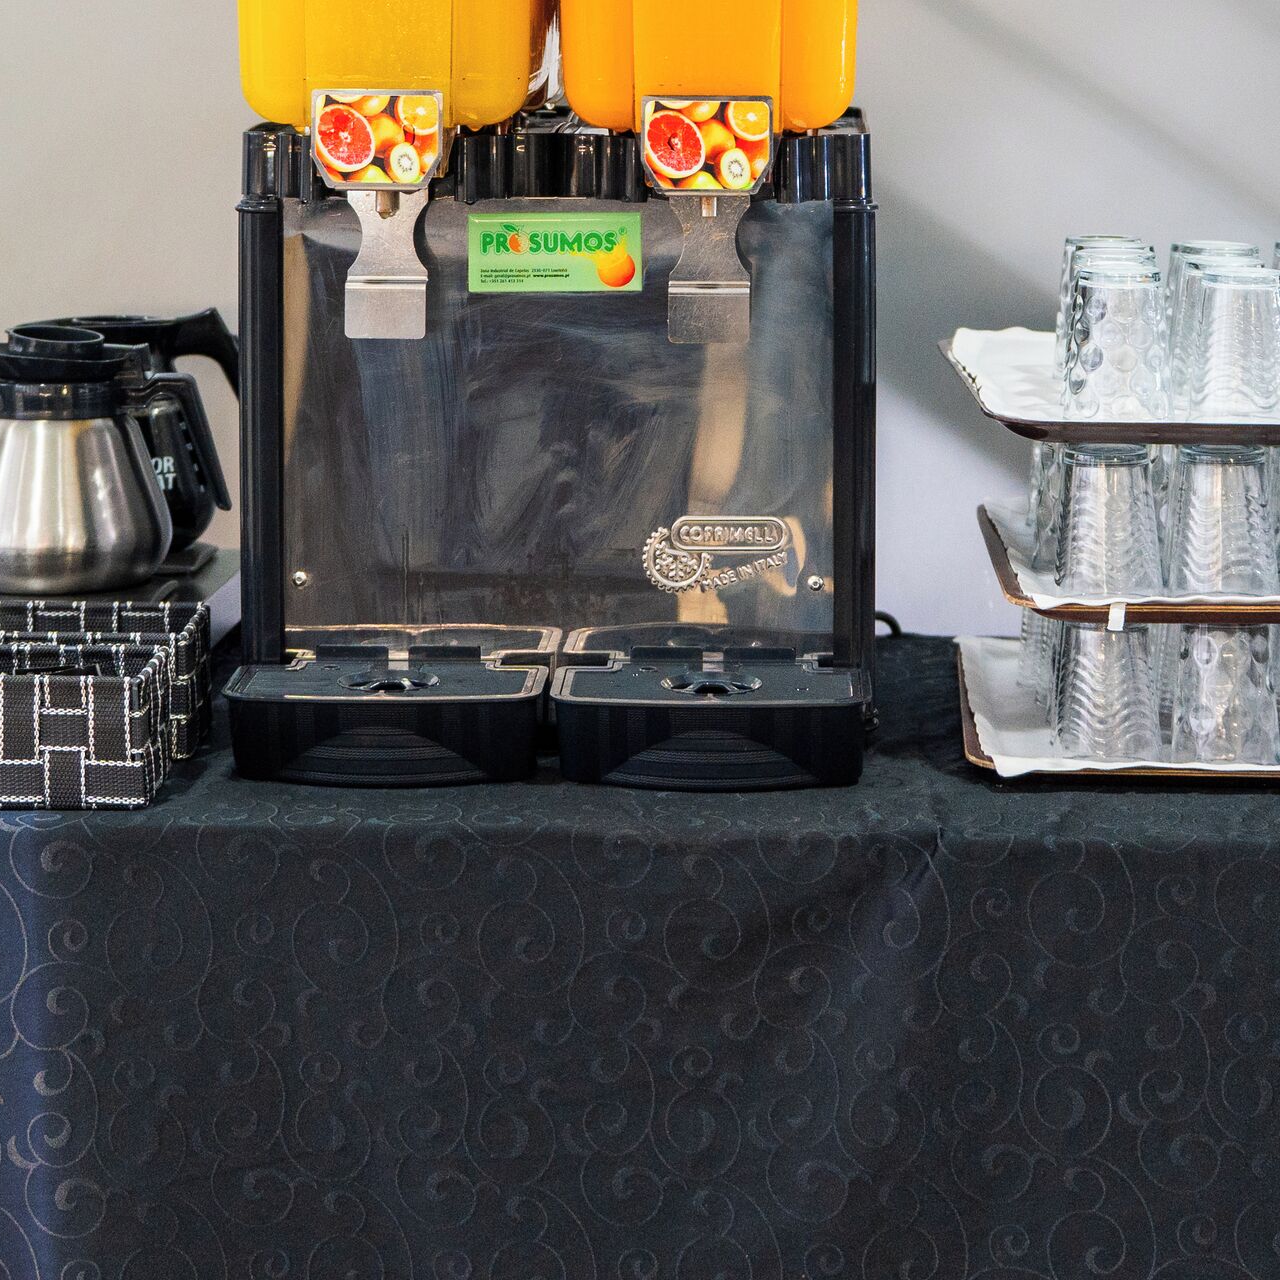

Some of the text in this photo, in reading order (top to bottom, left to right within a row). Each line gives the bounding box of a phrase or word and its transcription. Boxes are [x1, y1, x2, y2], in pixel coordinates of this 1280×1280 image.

[702, 551, 788, 592] MADE IN ITALY
